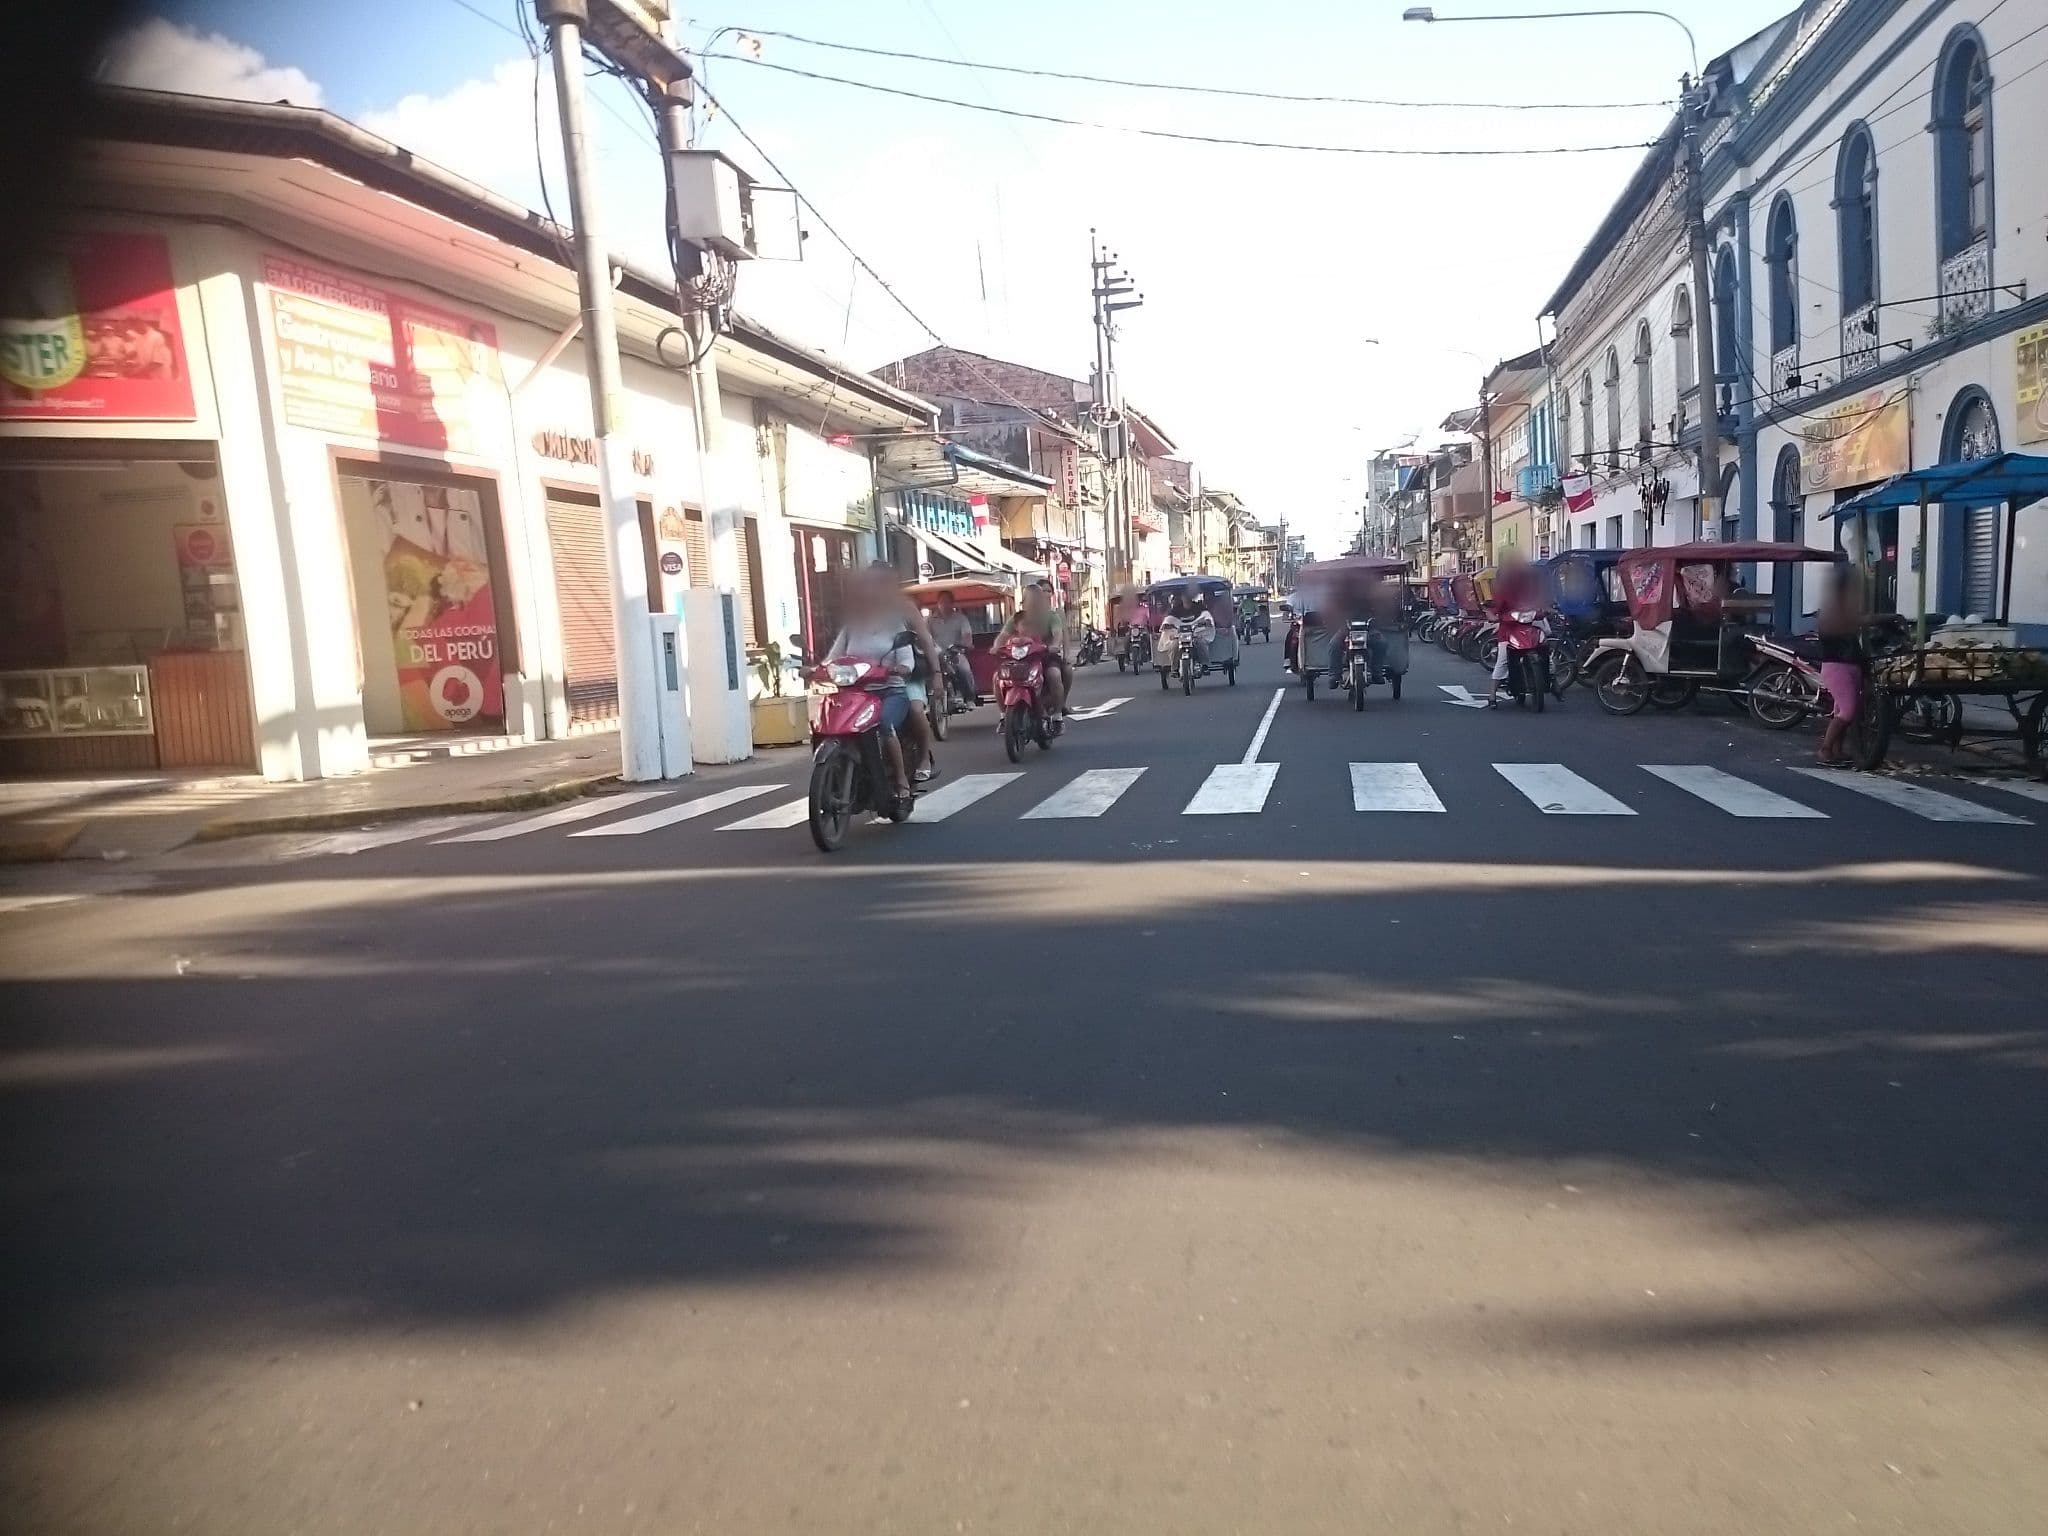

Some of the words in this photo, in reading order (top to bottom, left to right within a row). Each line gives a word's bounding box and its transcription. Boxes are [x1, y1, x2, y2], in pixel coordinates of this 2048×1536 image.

[434, 627, 453, 638] LAS
[410, 644, 442, 663] DEL
[447, 635, 494, 661] PERÚ
